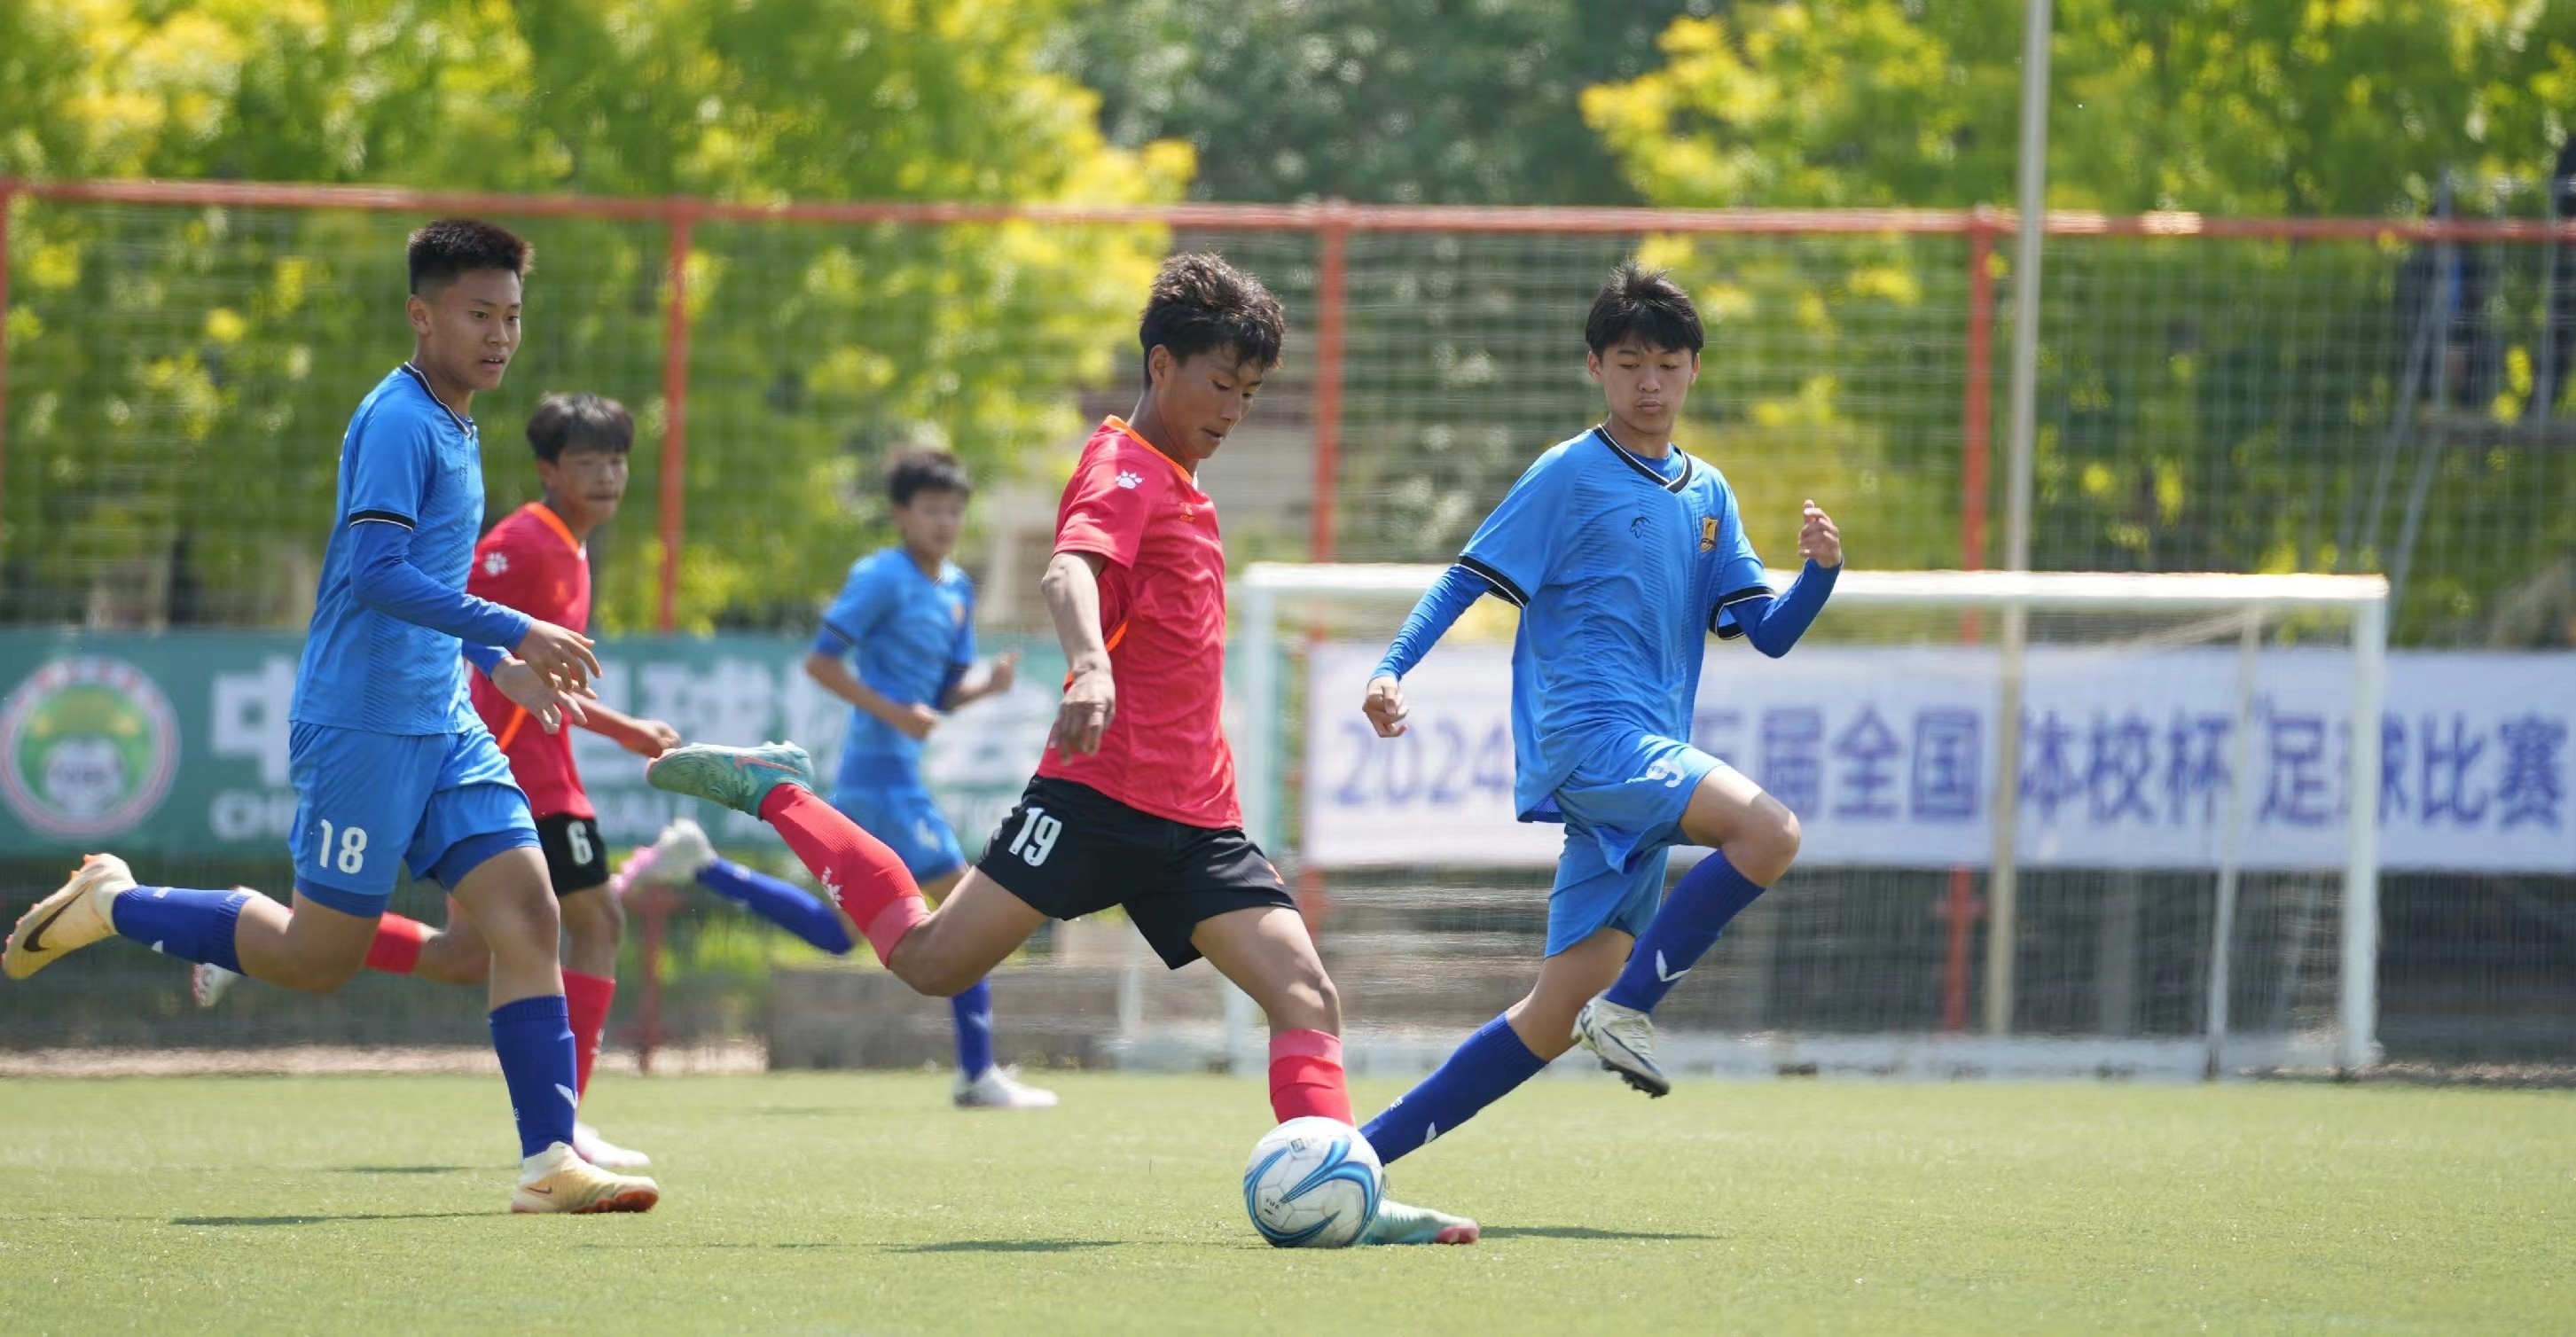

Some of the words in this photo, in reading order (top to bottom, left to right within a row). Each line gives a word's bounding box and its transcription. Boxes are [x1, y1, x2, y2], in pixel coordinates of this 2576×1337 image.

[319, 818, 368, 874] 18
[567, 820, 594, 865] 6
[1008, 807, 1063, 866] 19
